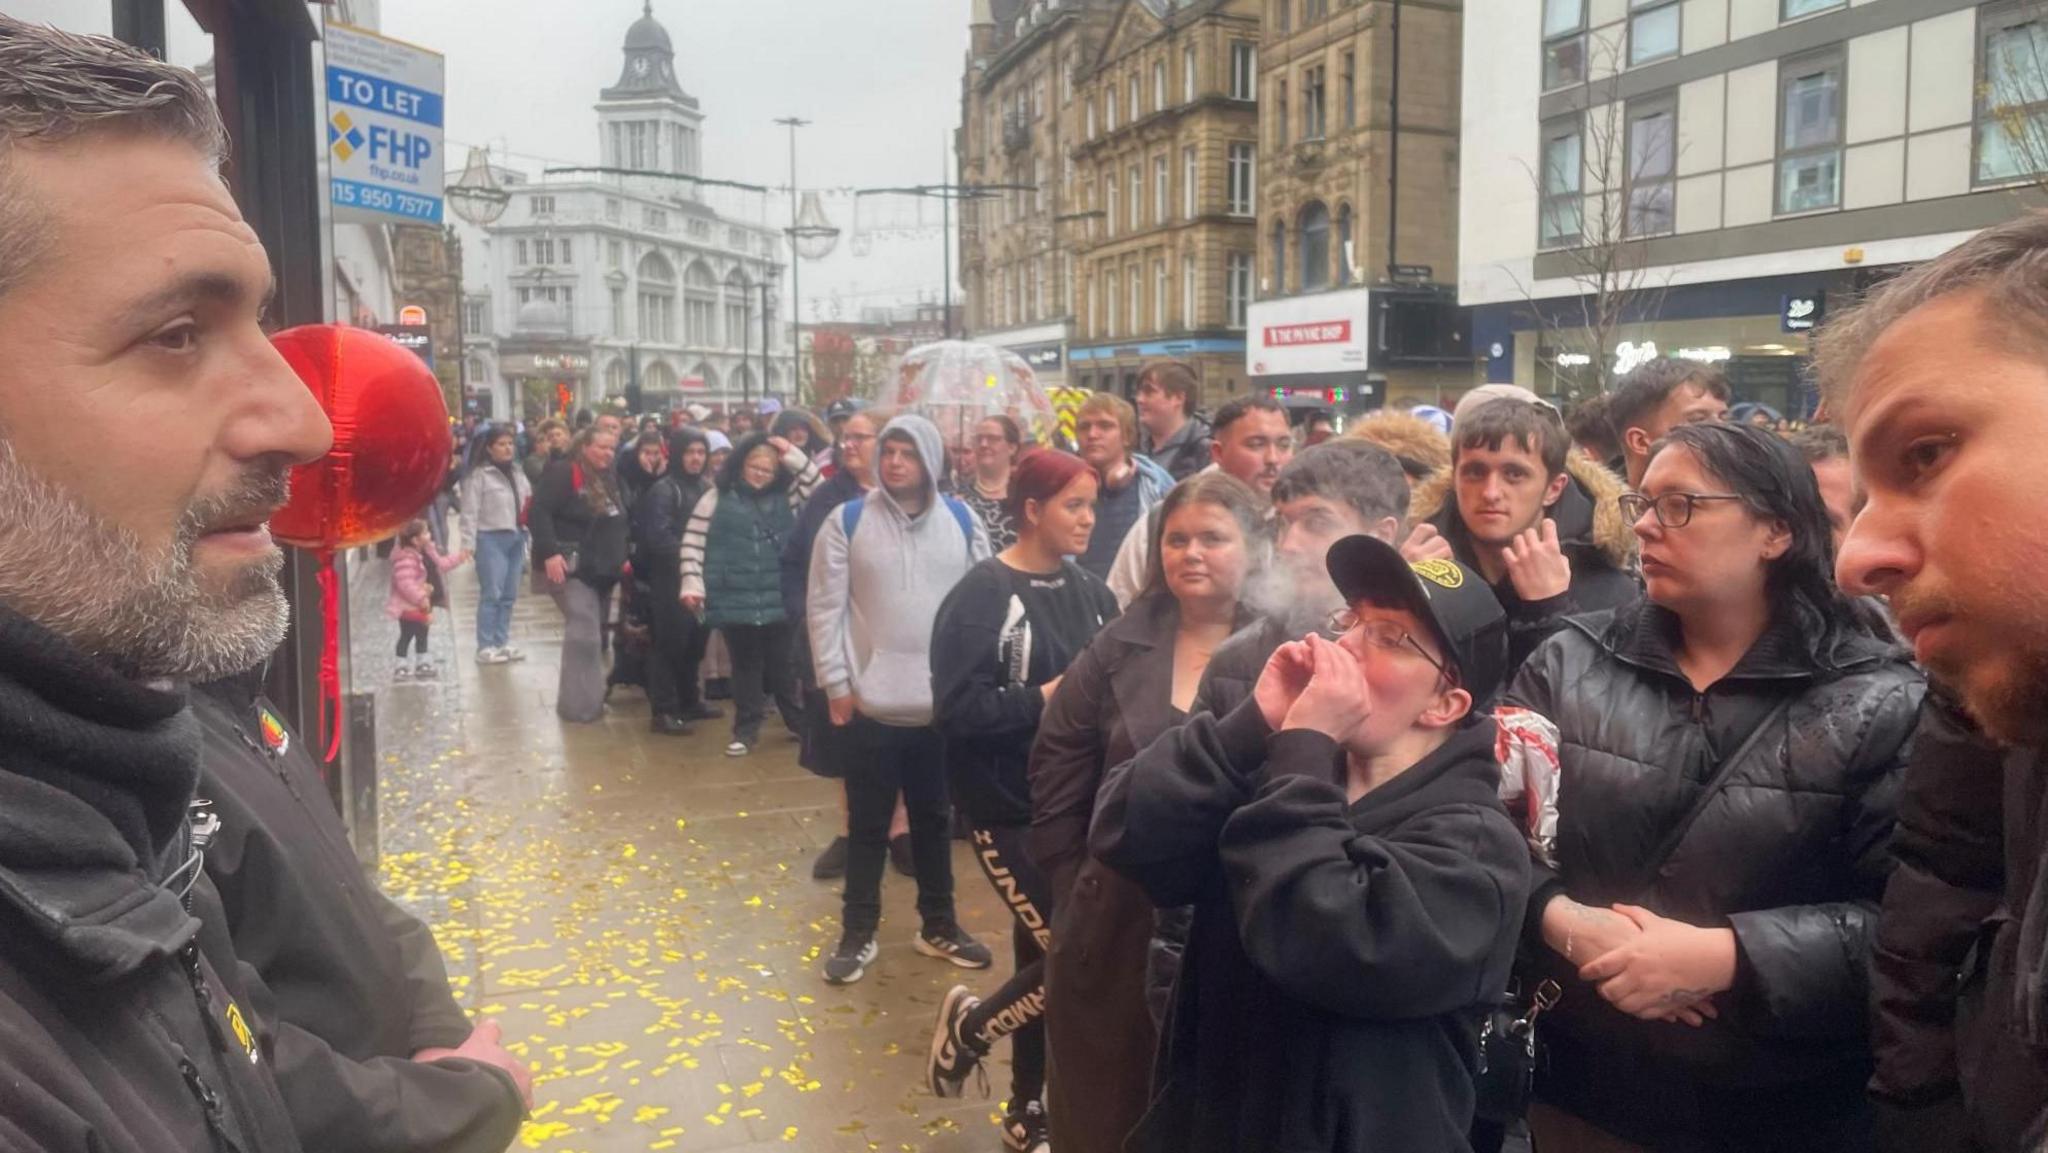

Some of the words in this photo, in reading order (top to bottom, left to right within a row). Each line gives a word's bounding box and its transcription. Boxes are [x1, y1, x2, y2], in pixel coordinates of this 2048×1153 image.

[338, 74, 373, 104] TO
[381, 85, 422, 116] LET
[369, 125, 431, 169] FHP
[369, 163, 419, 185] fhp.co.uk
[360, 188, 392, 209] 950
[397, 194, 433, 217] 7577
